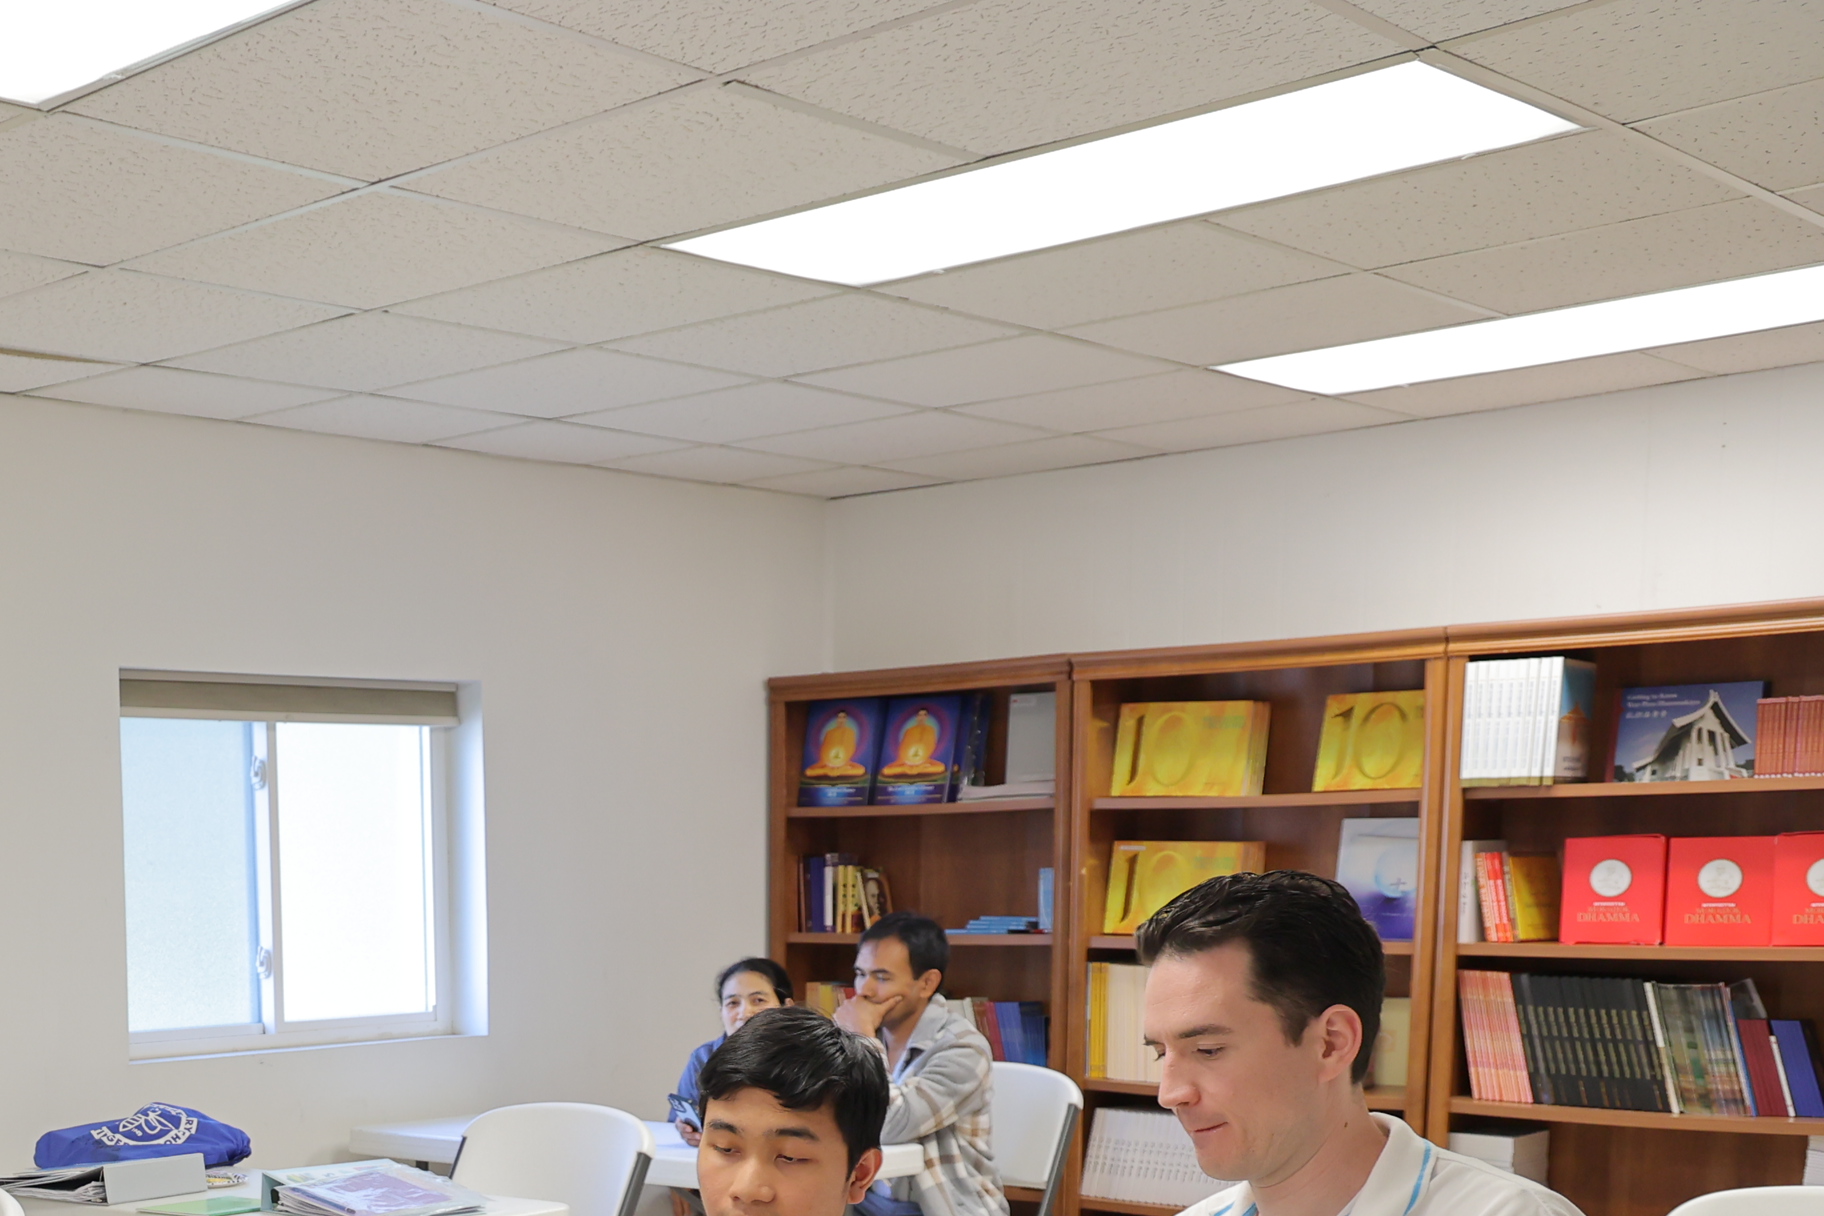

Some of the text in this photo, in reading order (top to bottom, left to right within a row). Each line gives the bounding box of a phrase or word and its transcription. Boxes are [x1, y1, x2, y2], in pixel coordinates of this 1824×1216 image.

[1577, 912, 1641, 922] DHAMMA
[1684, 914, 1751, 924] DHAMMA
[1792, 914, 1824, 924] DHA
